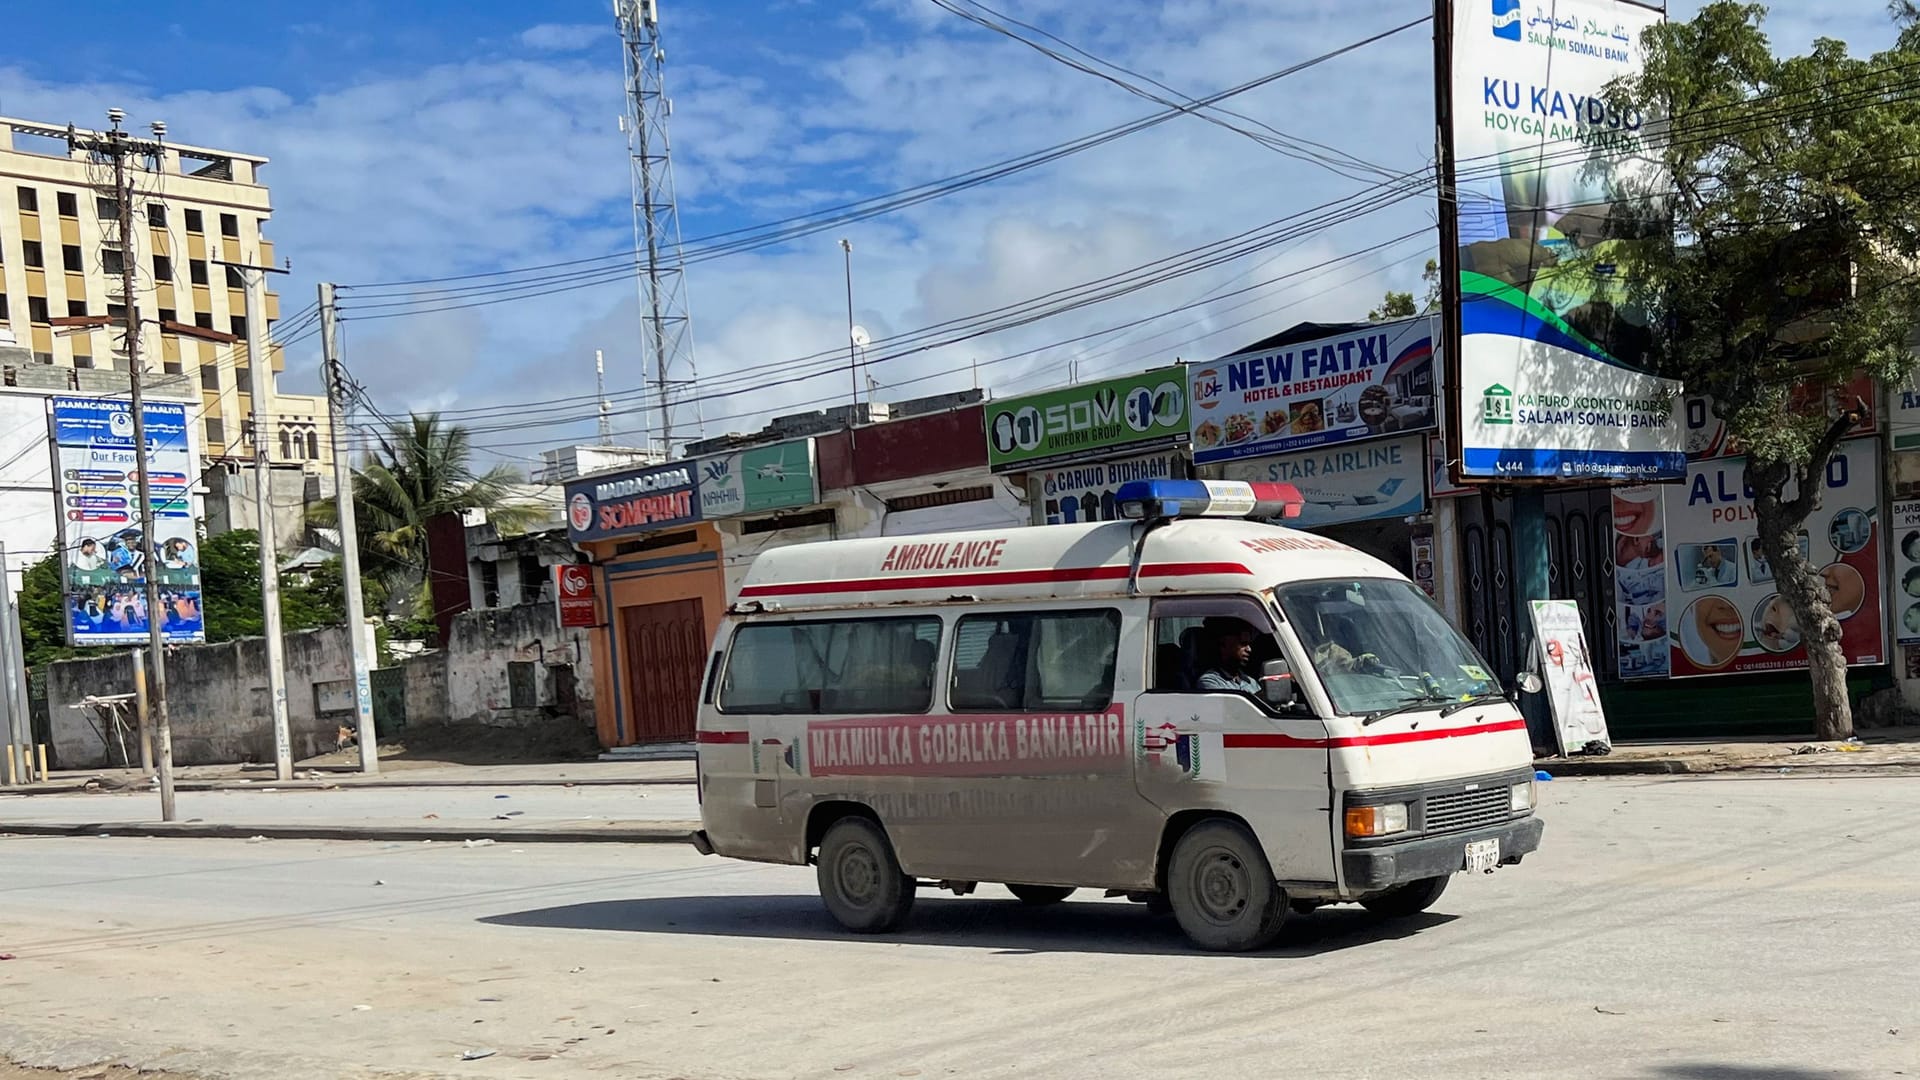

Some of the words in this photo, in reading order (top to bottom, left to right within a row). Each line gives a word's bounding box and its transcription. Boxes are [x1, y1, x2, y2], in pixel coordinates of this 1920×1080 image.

[1527, 6, 1579, 32] الصومالي
[1583, 19, 1608, 40] سلام
[1612, 24, 1630, 46] بنك
[1527, 31, 1567, 51] SALAAM
[1568, 40, 1603, 58] SOMALI
[1604, 47, 1630, 64] BANK
[1483, 76, 1520, 110] KU
[1530, 84, 1642, 131] KAYDSO
[1484, 110, 1544, 137] HOYGA
[1228, 352, 1293, 392] NEW
[1302, 334, 1389, 379] FATXI
[1243, 390, 1281, 404] HOTEL
[1282, 385, 1293, 397] &
[1294, 368, 1374, 395] RESTAURANT
[124, 404, 183, 415] SMAALIYA
[1046, 392, 1120, 435] SOM
[1518, 395, 1535, 408] KA
[1537, 395, 1570, 408] FURO
[1573, 396, 1622, 411] KOONTO
[1518, 409, 1574, 425] SALAAM
[1578, 411, 1627, 427] SOMALI
[1630, 414, 1666, 428] BANK
[1048, 430, 1089, 449] UNIFORM
[1092, 424, 1122, 440] GROUP
[91, 451, 109, 462] Our
[1268, 461, 1316, 482] STAR
[1322, 444, 1403, 475] AIRLINE
[1504, 461, 1523, 471] 444
[1573, 461, 1658, 474] info@salaambank.so
[596, 467, 692, 501] MADBACADDA
[1057, 465, 1104, 491] CARWO
[1108, 456, 1167, 484] BIDHAAN
[600, 489, 694, 531] SOMPRINT
[880, 538, 1008, 571] AMBULANCE
[812, 725, 914, 767] MAAMULKA
[919, 720, 1011, 765] GOBALKA
[1016, 713, 1121, 760] BANAADIR
